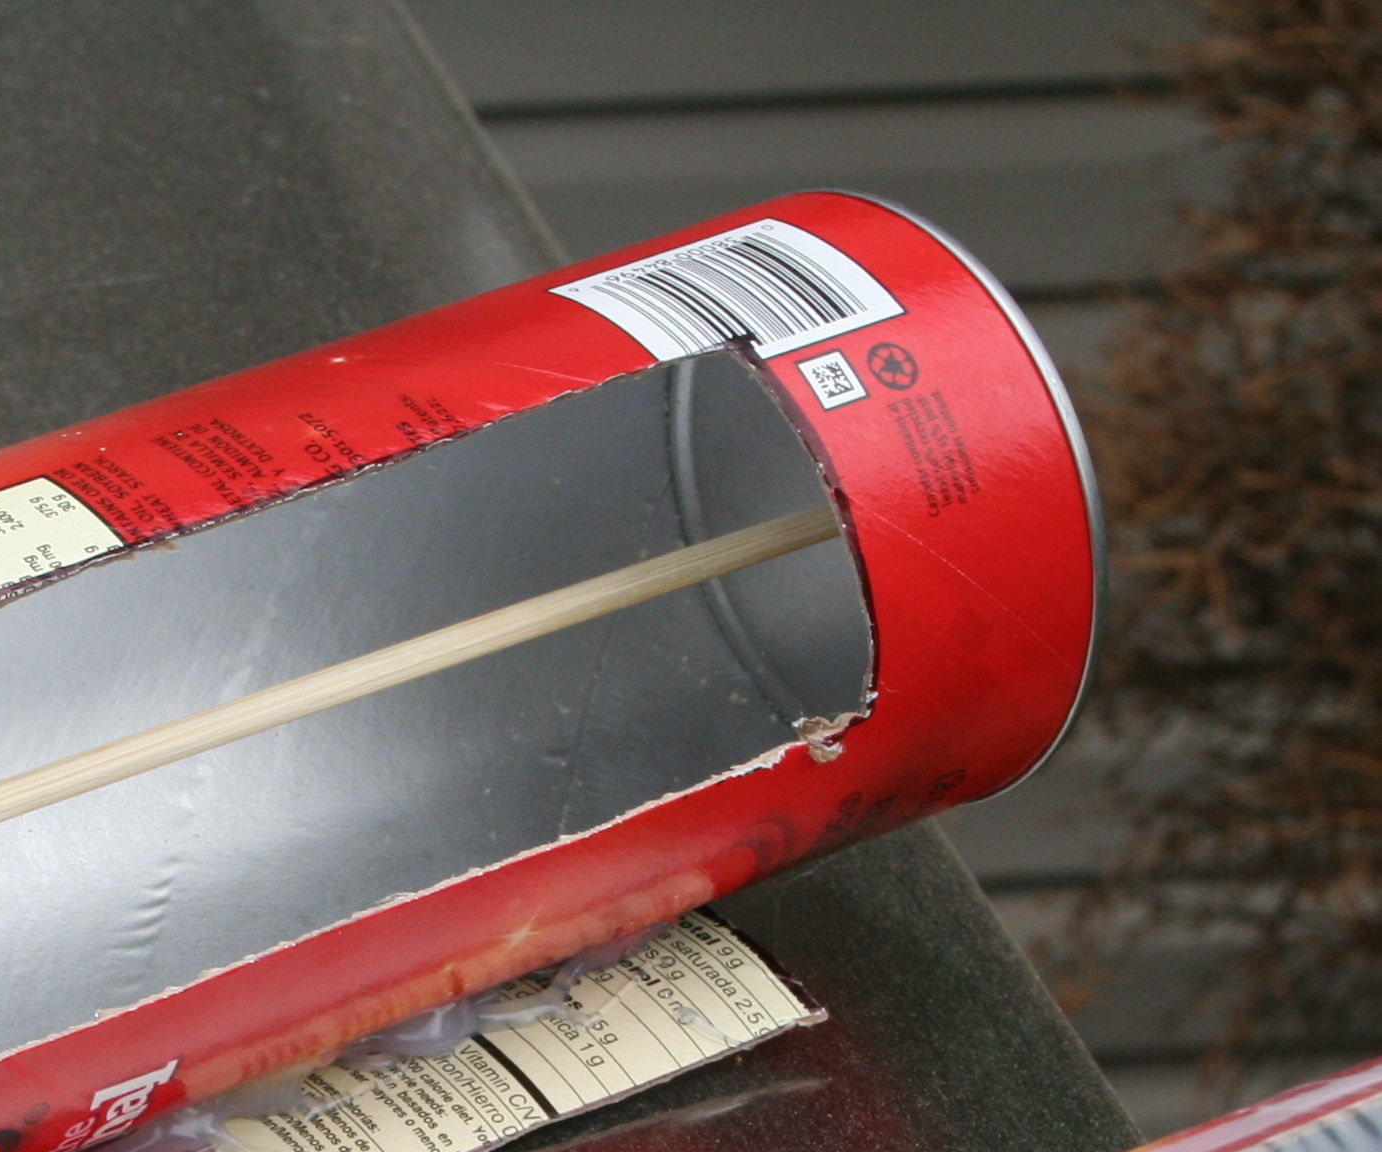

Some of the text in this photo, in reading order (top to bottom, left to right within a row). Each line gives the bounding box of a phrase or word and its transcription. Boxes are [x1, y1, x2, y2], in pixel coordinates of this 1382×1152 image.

[670, 938, 737, 998] saturada
[421, 1073, 454, 1103] calorie
[460, 1044, 510, 1093] Vitamin
